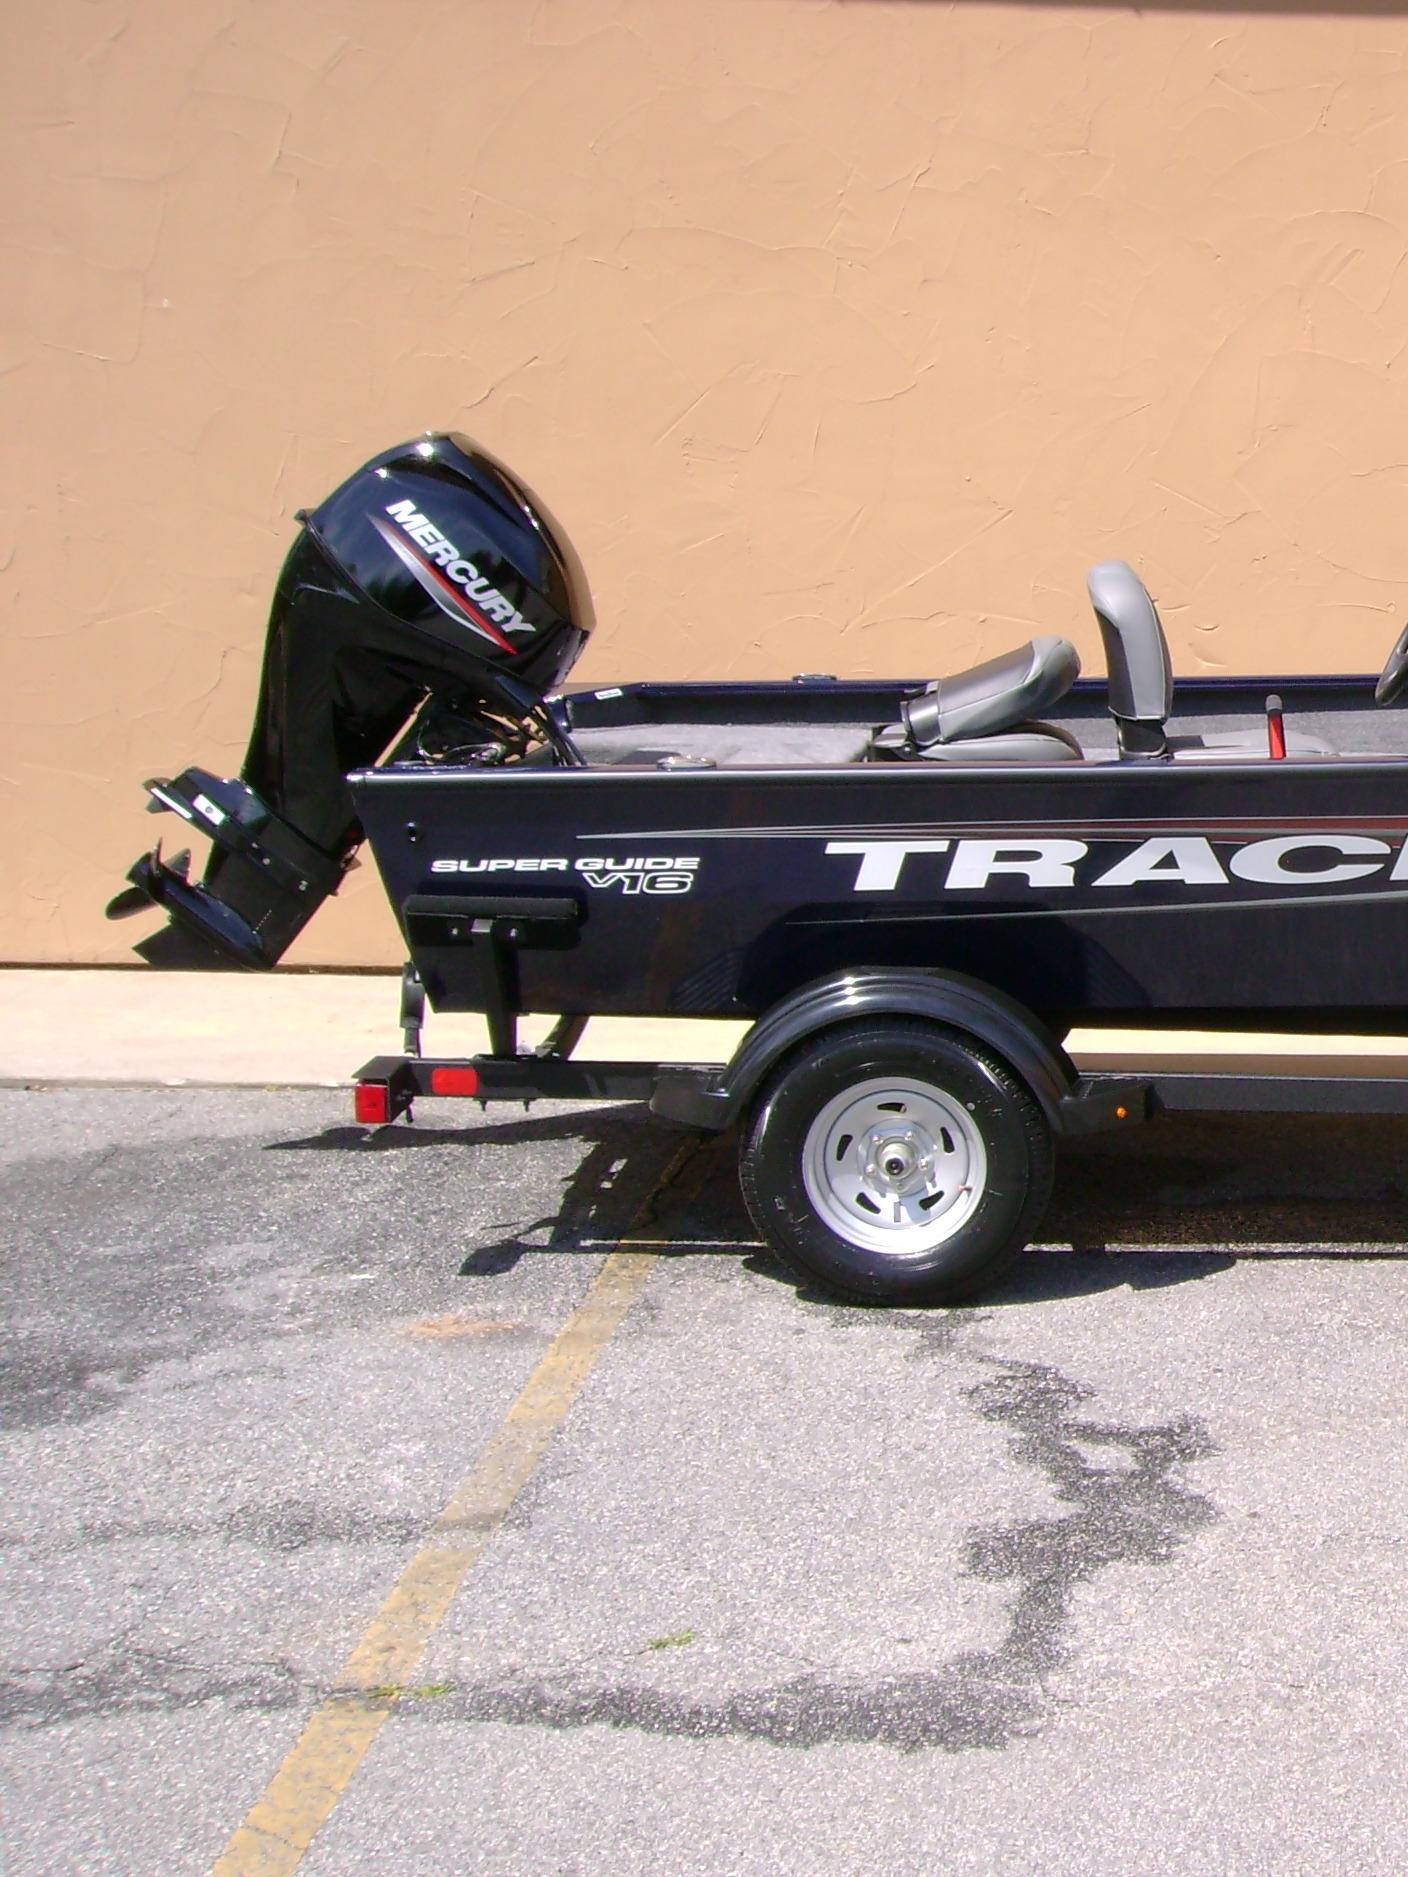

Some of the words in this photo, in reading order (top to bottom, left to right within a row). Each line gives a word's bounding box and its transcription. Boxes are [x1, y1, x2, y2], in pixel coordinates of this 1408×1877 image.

[385, 499, 536, 632] MERCURY
[430, 857, 570, 873] SUPER
[574, 856, 700, 871] GUIDE
[582, 870, 695, 895] V16
